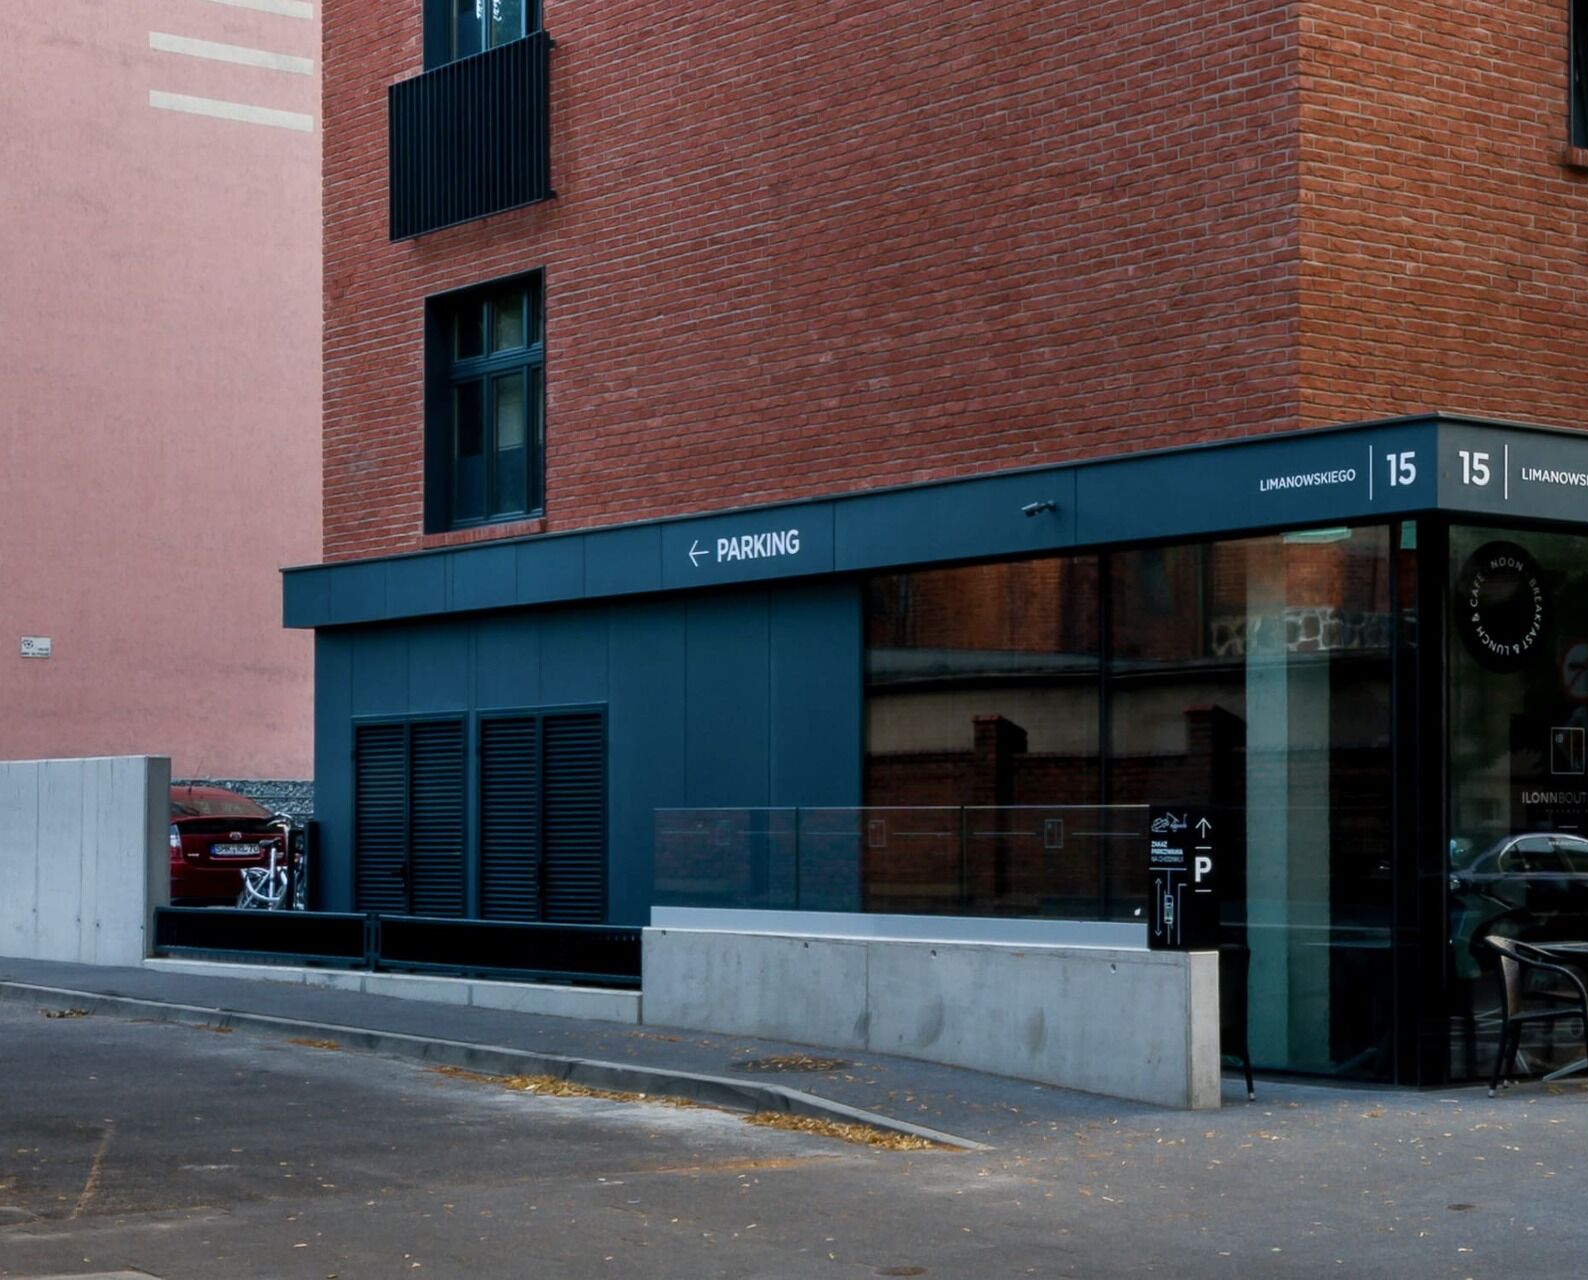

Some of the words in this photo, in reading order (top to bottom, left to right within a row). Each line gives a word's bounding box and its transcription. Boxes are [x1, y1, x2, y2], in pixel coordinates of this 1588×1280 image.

[1260, 468, 1356, 492] LIMANOWSKIEGO
[1386, 451, 1417, 487] 15
[1458, 450, 1491, 487] 15
[717, 529, 800, 563] PARKING
[1490, 557, 1524, 572] NOON
[1522, 577, 1543, 651] BREAKFAST
[1476, 626, 1511, 657] LUNCH
[1194, 856, 1213, 883] P
